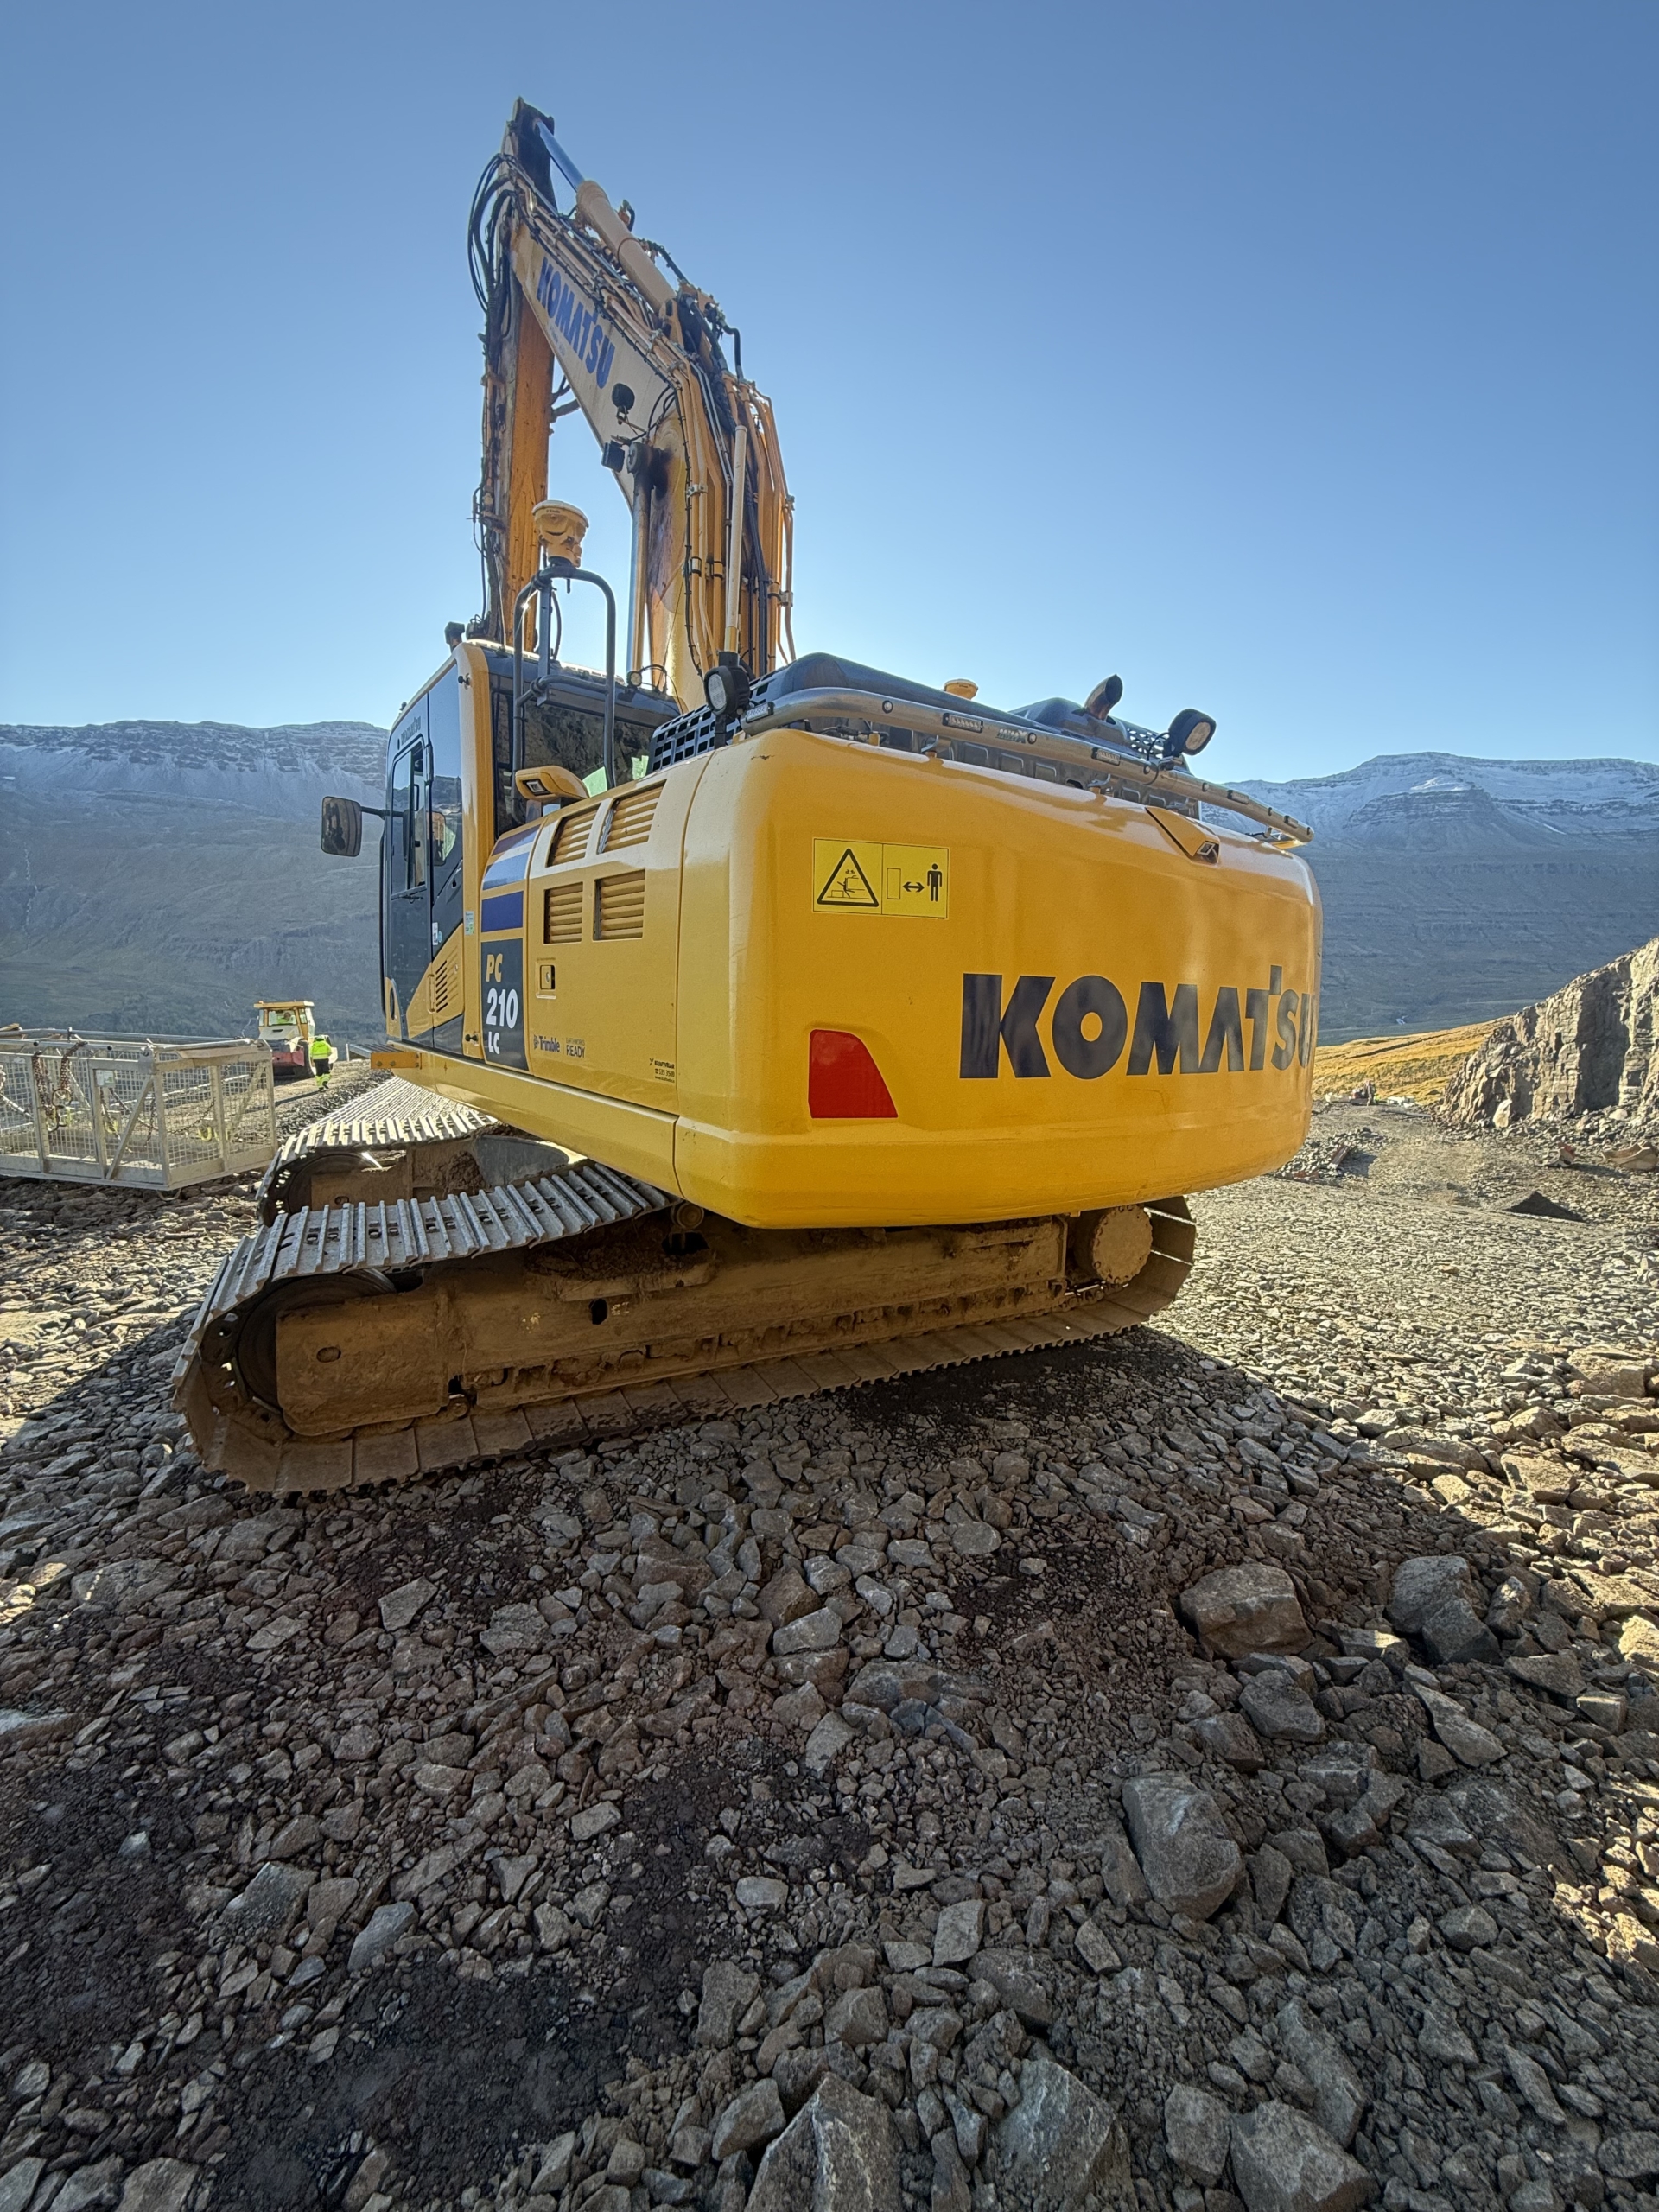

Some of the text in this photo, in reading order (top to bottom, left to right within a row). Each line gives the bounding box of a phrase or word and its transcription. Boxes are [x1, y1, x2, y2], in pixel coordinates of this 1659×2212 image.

[537, 257, 615, 389] KOMATSU
[486, 953, 503, 982] PC
[486, 988, 518, 1028] 210
[959, 965, 1313, 1079] KOMATSU
[487, 1031, 500, 1054] LC
[539, 1036, 560, 1052] Trimble
[566, 1045, 585, 1058] READY
